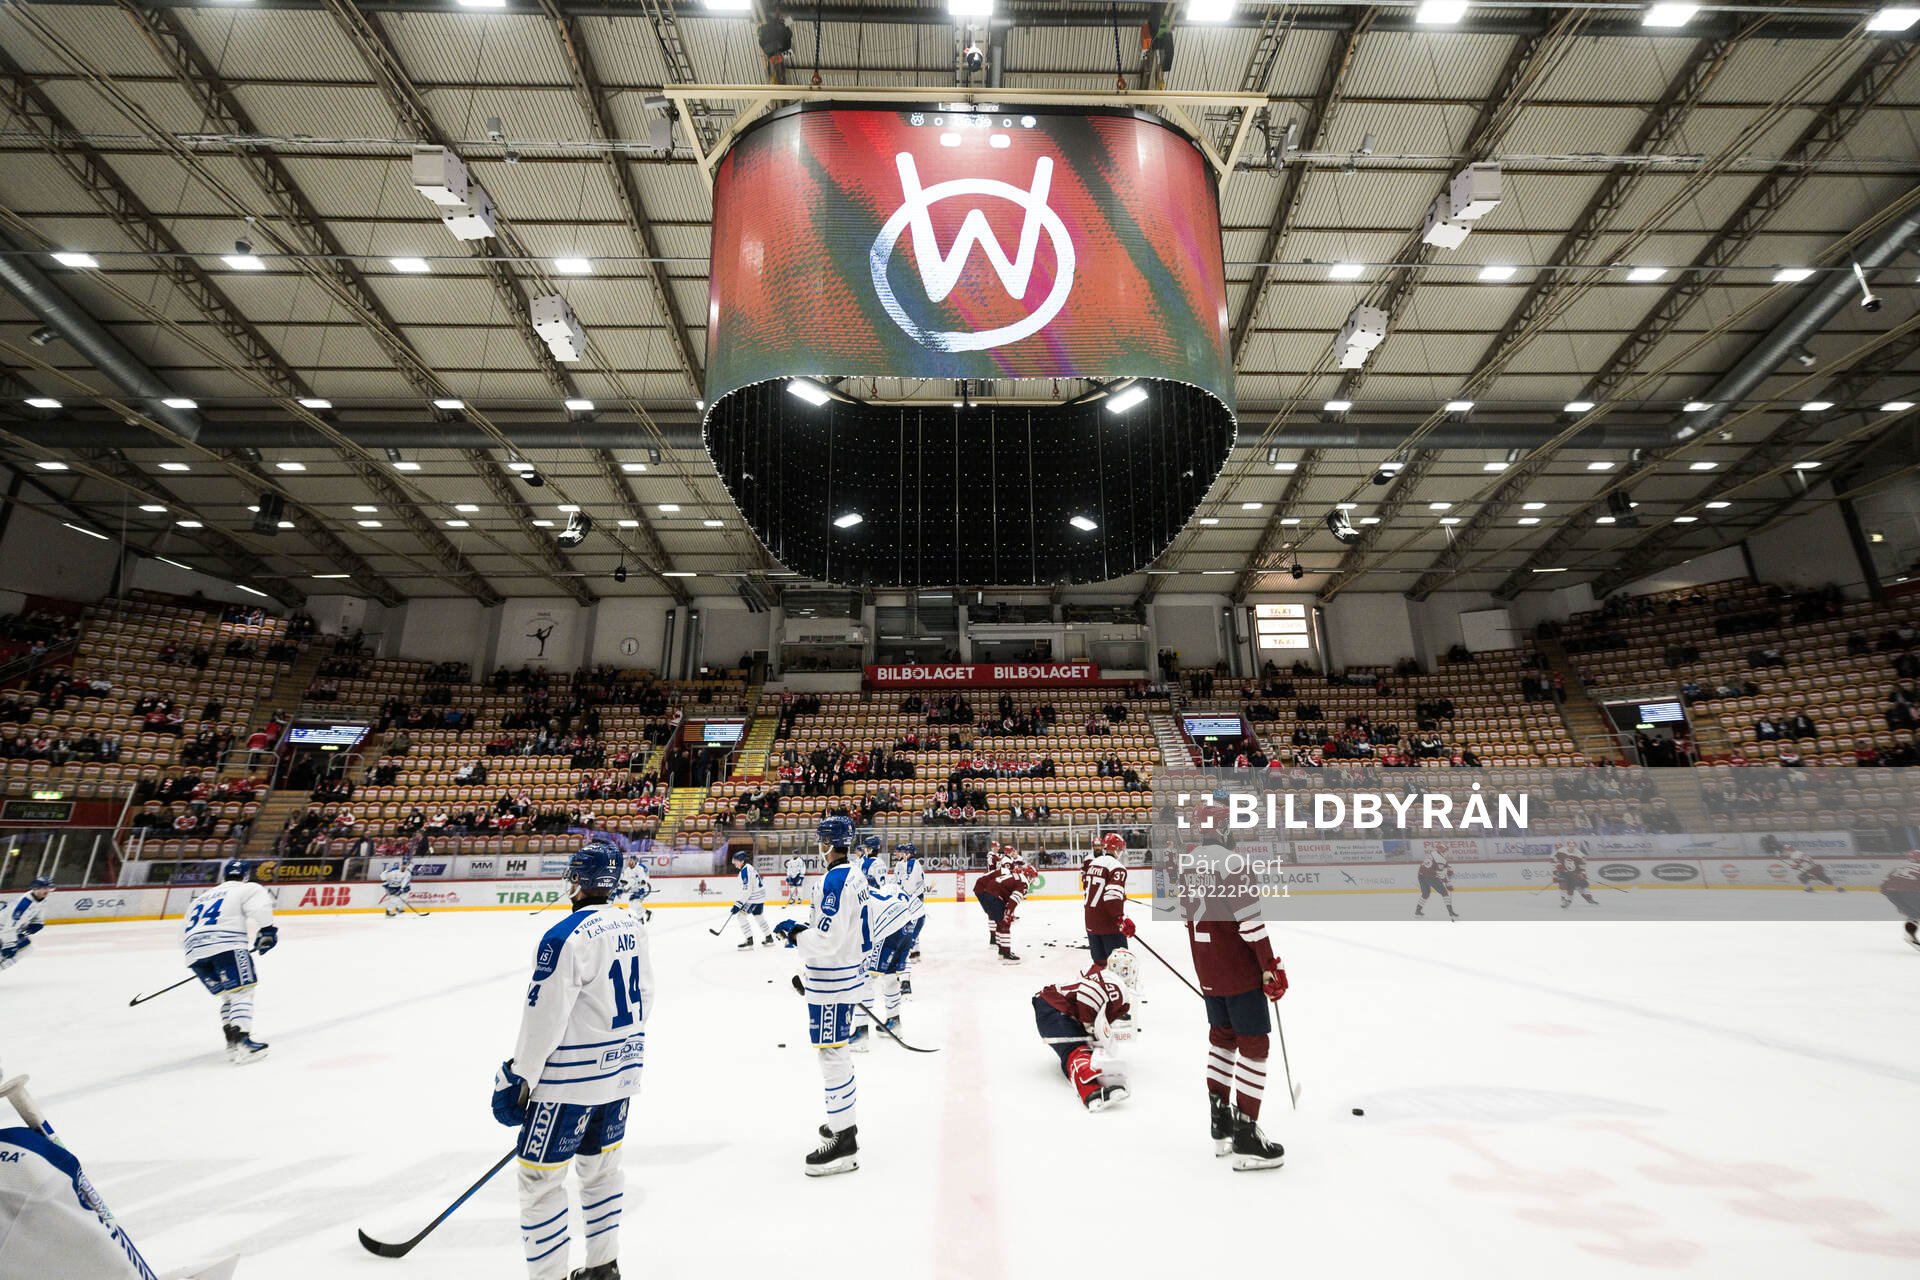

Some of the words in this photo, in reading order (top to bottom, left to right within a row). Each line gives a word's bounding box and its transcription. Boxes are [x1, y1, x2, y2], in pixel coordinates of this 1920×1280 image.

[877, 667, 975, 681] BILBOLAGET
[994, 666, 1090, 679] BILBOLAGET
[1297, 844, 1331, 852] BUCHER
[506, 860, 527, 871] HH
[1114, 871, 1124, 881] 37
[97, 899, 125, 908] SCA
[298, 887, 351, 907] ABB
[497, 891, 559, 904] TIRAB
[185, 898, 224, 933] 34
[818, 917, 832, 932] 16
[609, 956, 642, 1029] 14
